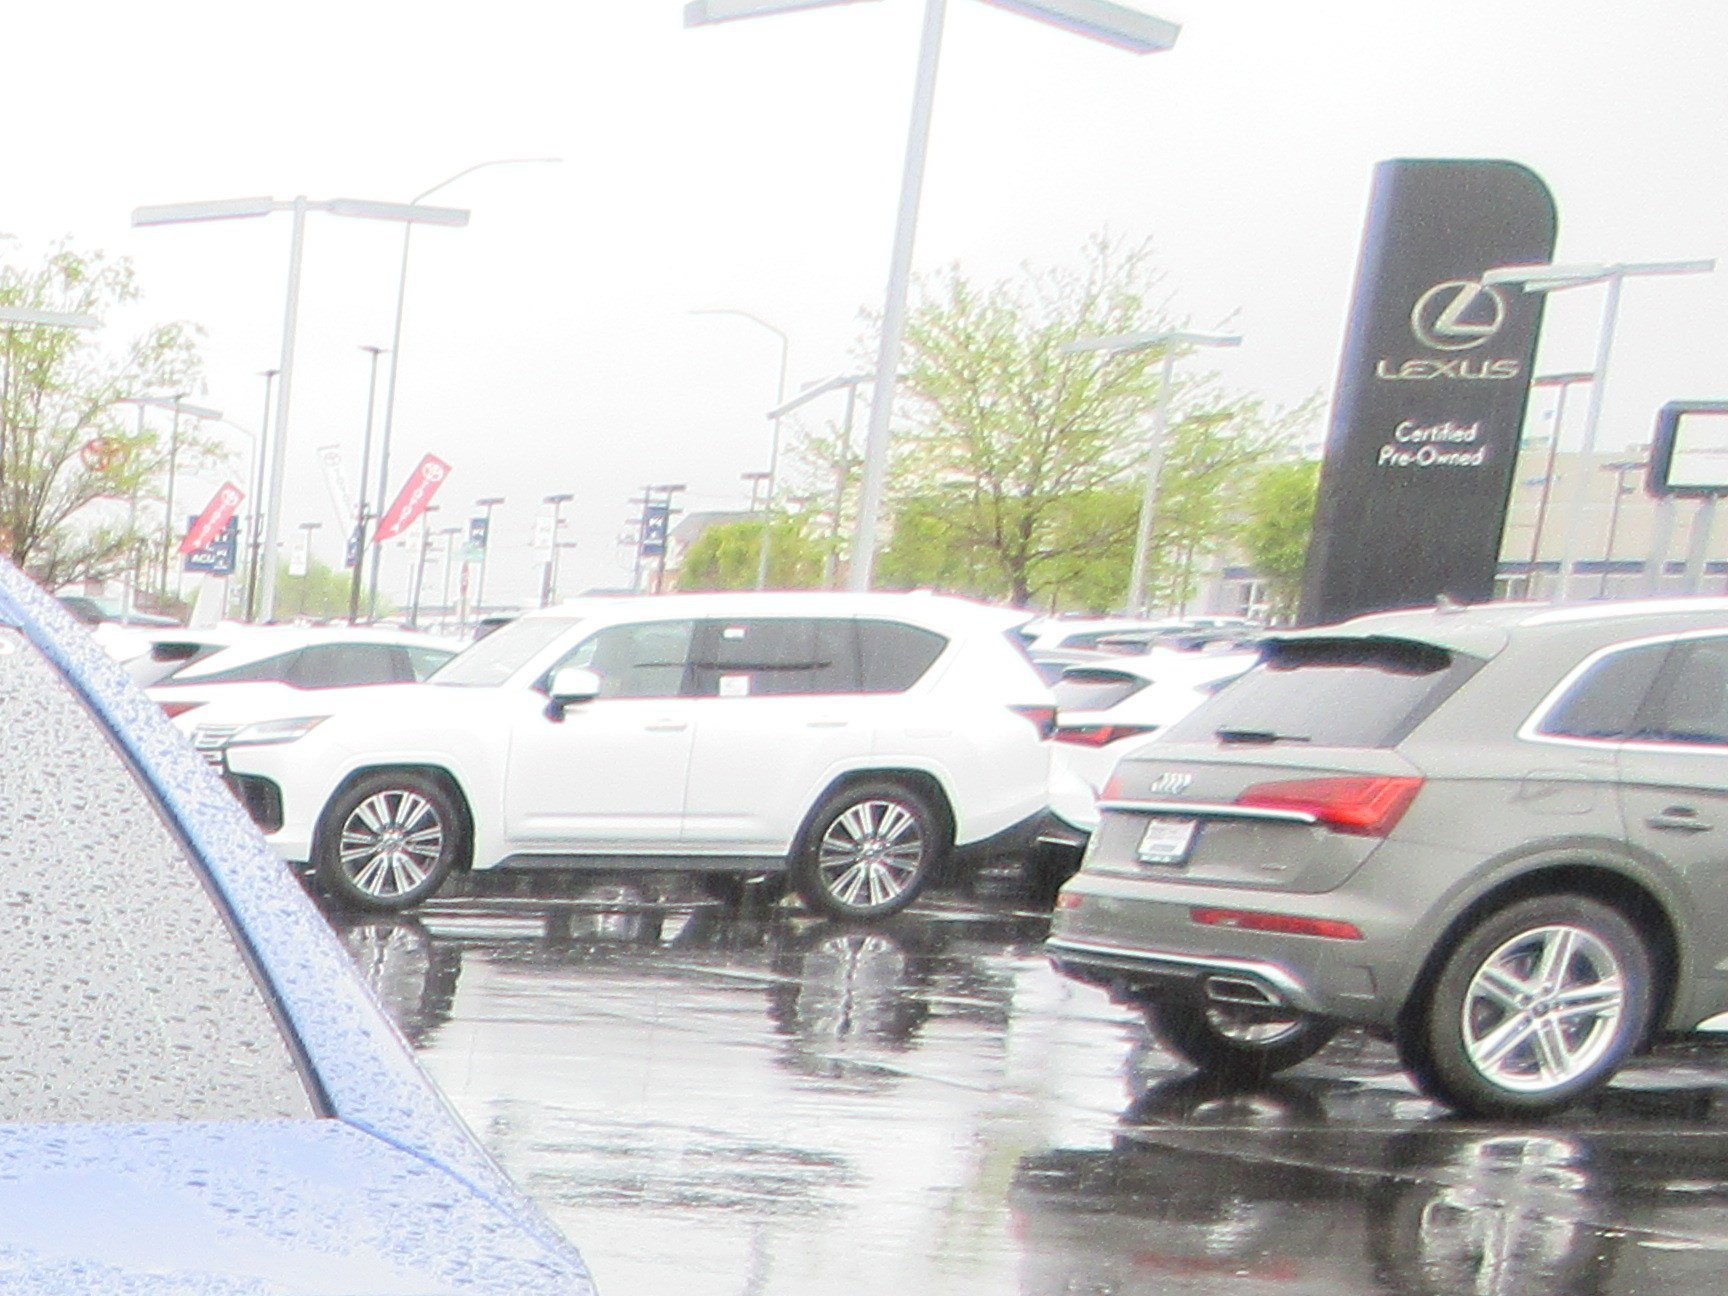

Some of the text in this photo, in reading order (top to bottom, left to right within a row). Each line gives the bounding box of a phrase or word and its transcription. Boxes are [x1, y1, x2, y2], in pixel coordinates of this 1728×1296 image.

[1376, 358, 1520, 380] LEXUS
[1395, 421, 1480, 443] Certified
[1378, 447, 1486, 467] Pre-Owned
